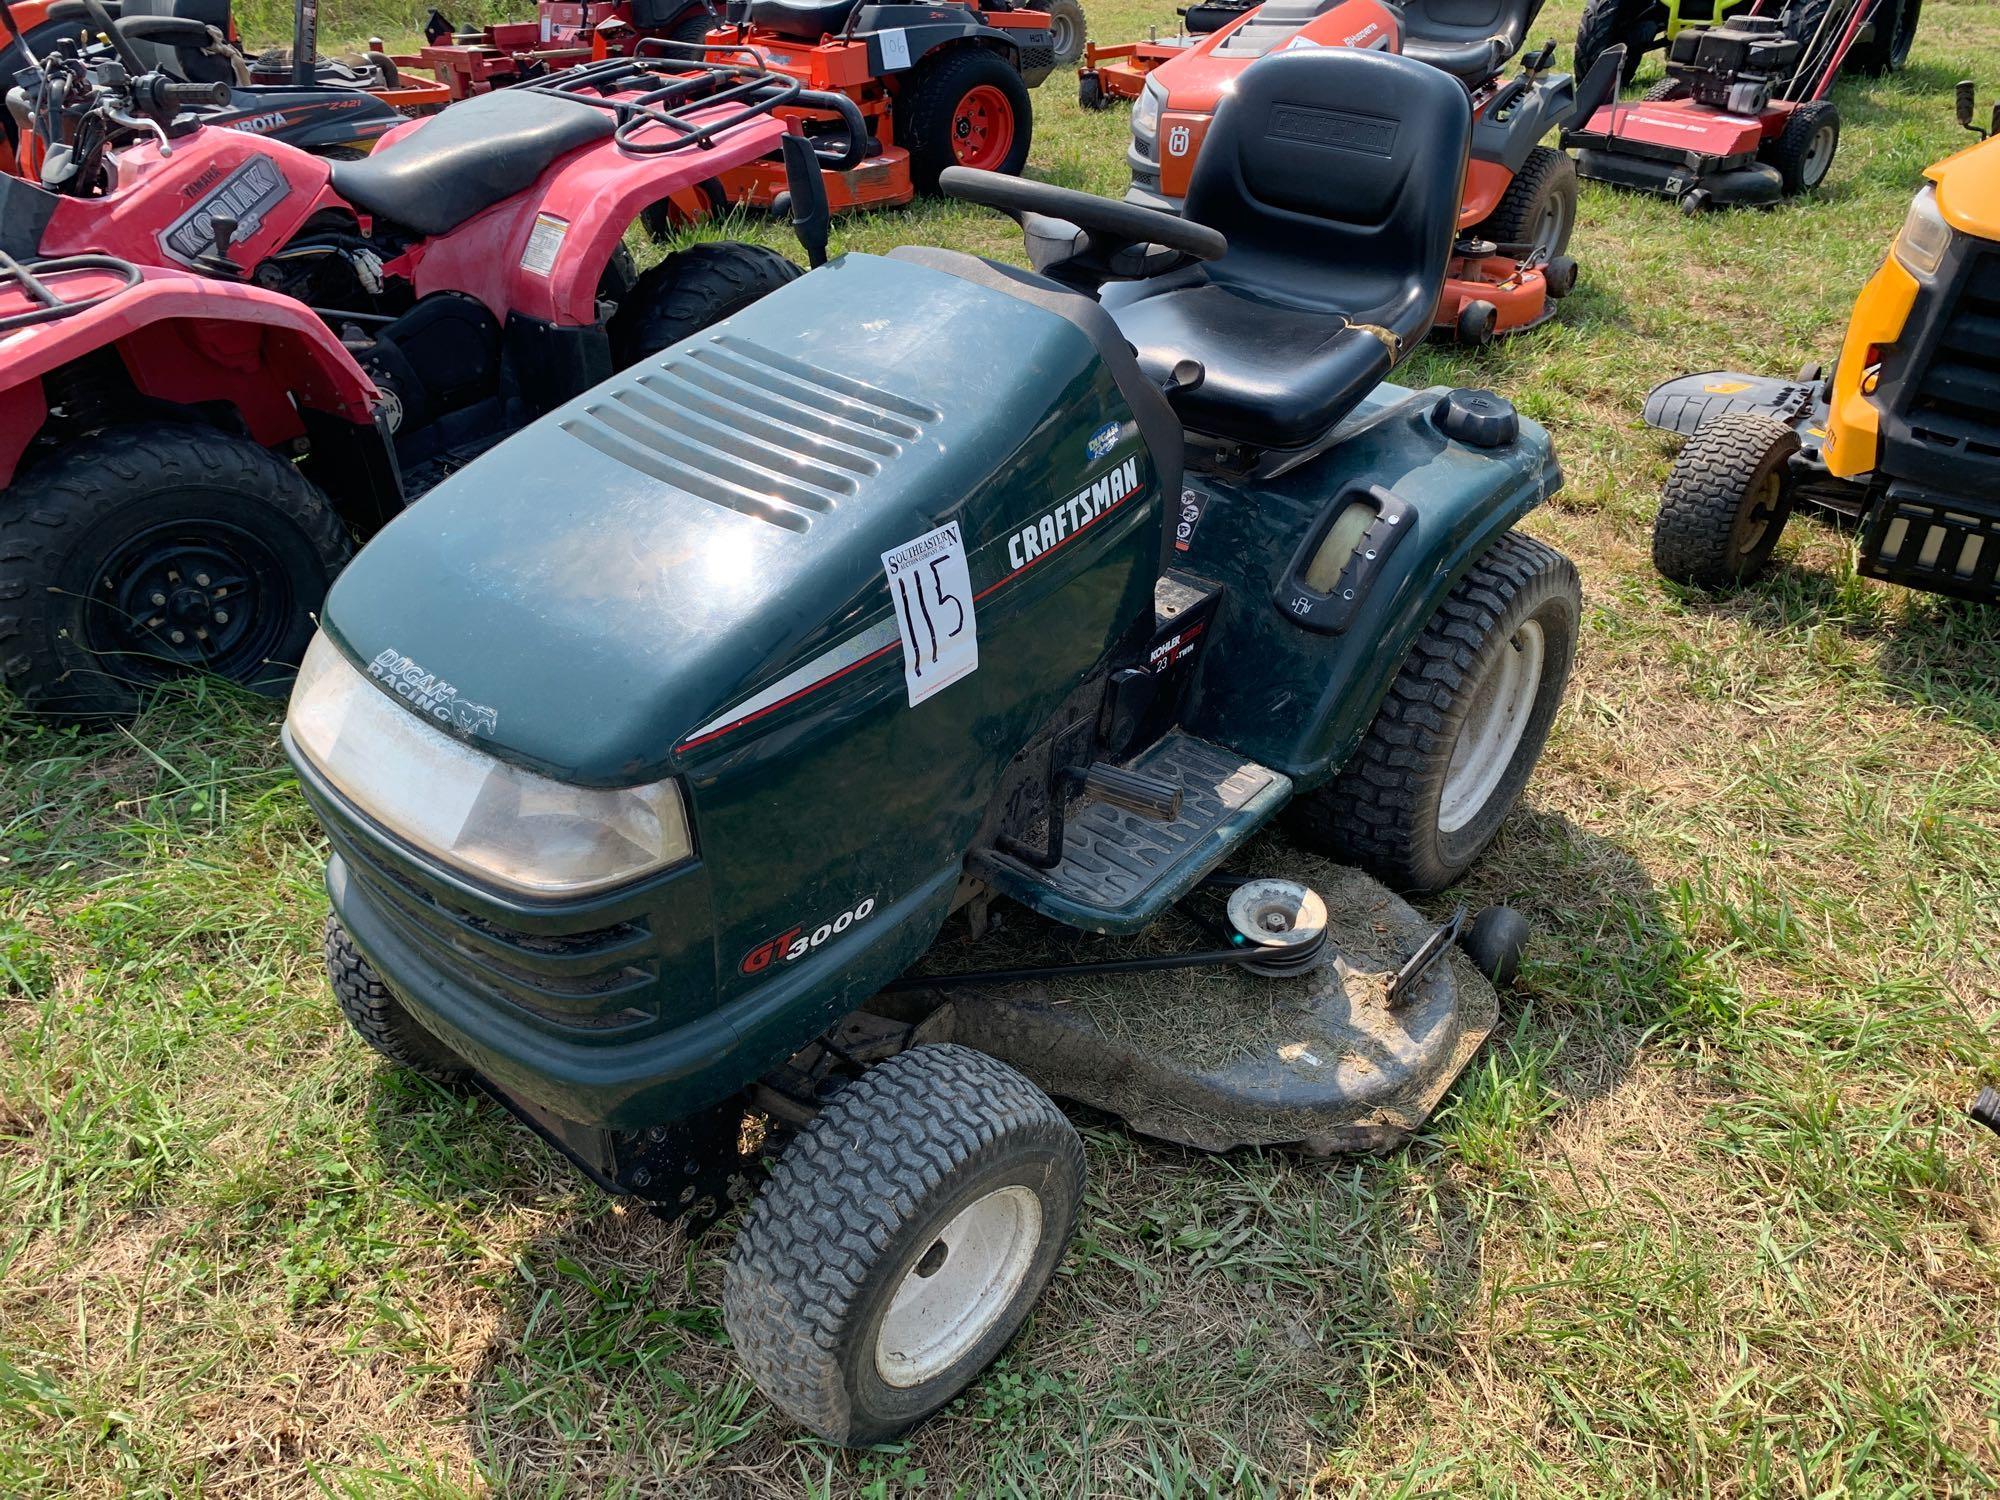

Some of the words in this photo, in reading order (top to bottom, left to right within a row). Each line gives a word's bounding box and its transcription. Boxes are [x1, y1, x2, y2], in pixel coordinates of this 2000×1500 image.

[184, 164, 221, 199] YAMAHA
[175, 165, 275, 255] KODIAK
[1008, 455, 1138, 570] CRAFTSMAN
[888, 527, 958, 575] SOUTHEASTERN
[898, 555, 964, 677] 115
[374, 648, 458, 703] DUGAN
[1151, 635, 1181, 663] KOHLER
[1156, 657, 1168, 674] 23
[367, 661, 451, 721] RACING
